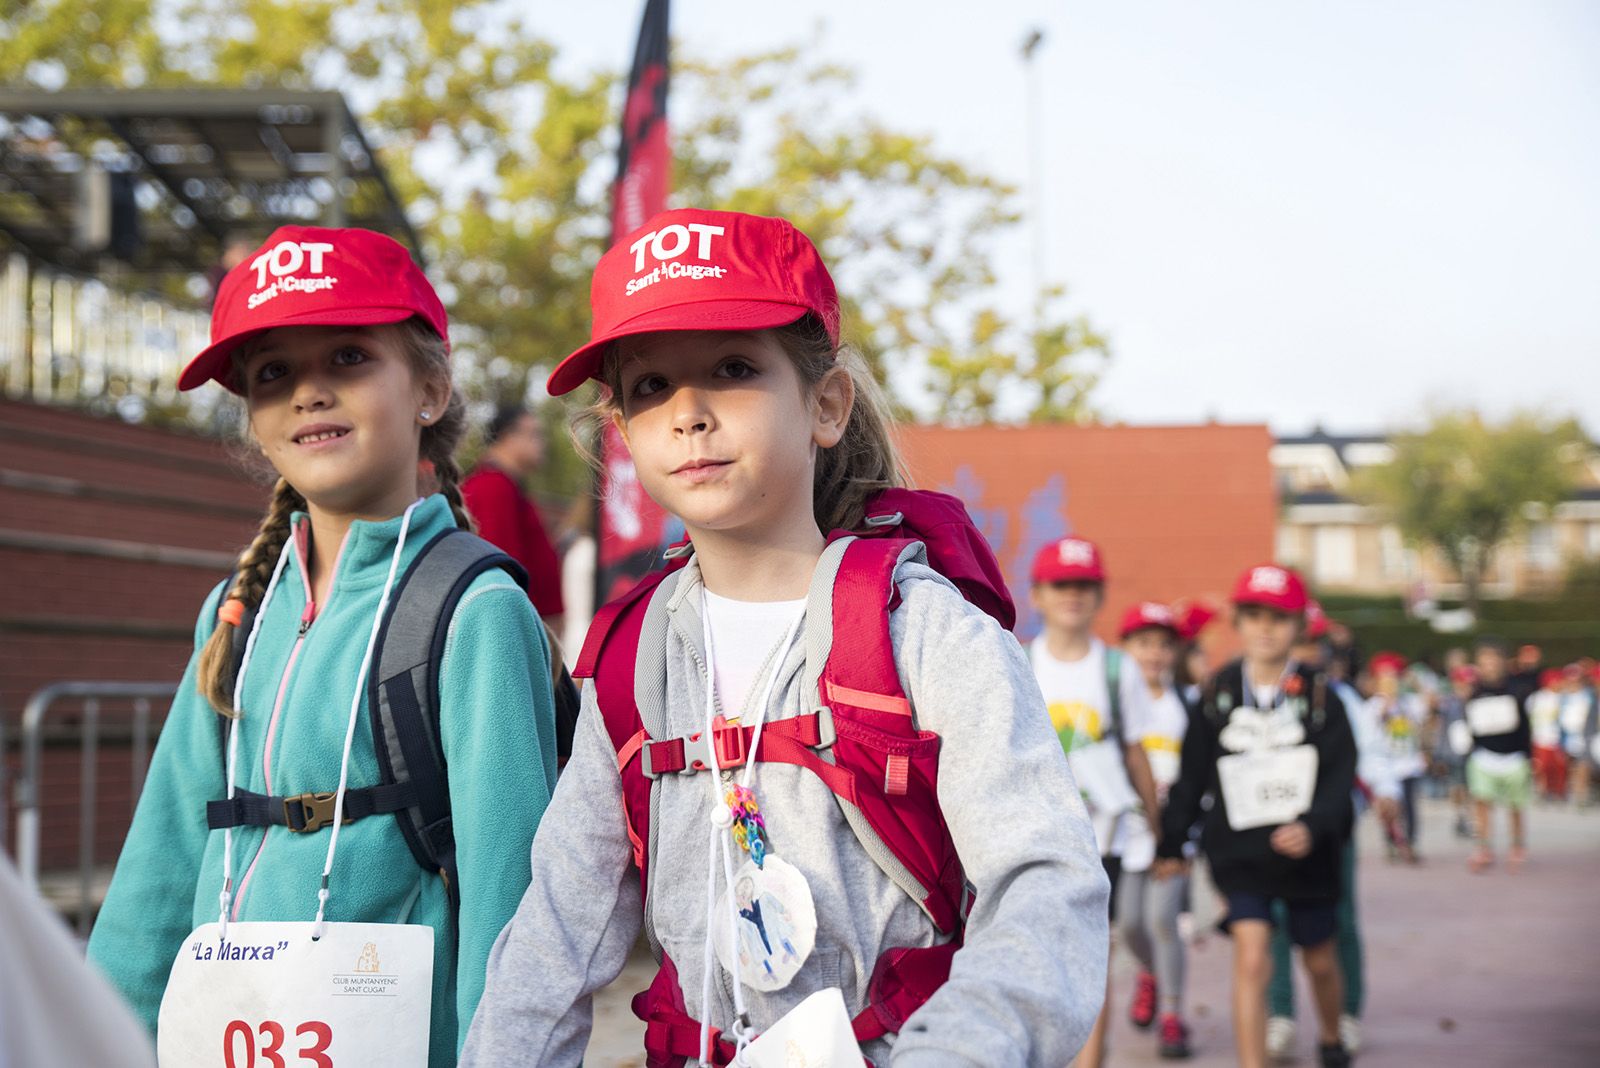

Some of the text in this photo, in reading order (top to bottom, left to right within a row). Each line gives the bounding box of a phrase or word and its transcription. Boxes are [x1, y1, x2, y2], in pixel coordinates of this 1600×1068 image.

[250, 241, 334, 289] TOT
[630, 223, 725, 273] TOT
[248, 276, 334, 309] Sant Cugat
[625, 261, 724, 297] Sant Cugat
[332, 977, 399, 986] CLUB MUNTANYENC
[343, 986, 386, 994] SANT CUGAT
[223, 1020, 334, 1068] 033
